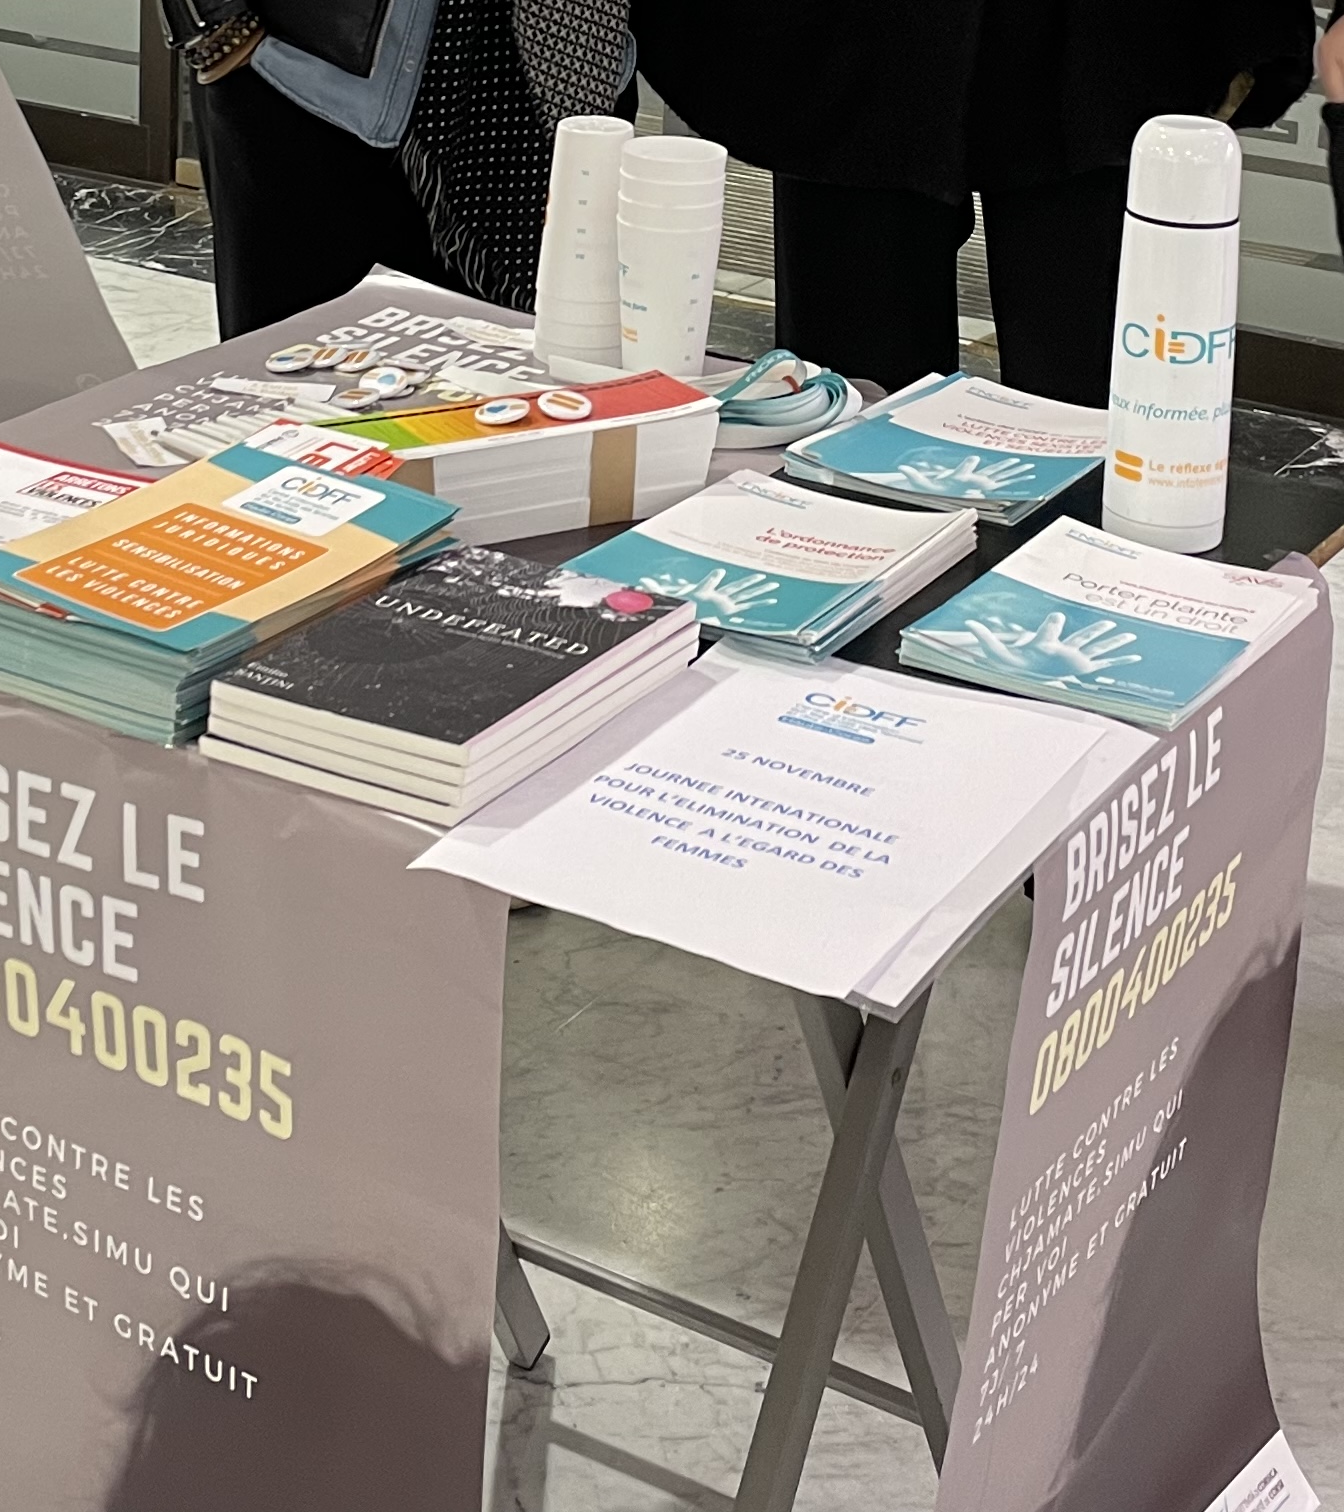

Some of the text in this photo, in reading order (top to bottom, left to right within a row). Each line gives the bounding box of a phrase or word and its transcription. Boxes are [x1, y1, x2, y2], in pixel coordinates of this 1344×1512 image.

[1149, 459, 1213, 476] Le réflexe
[110, 537, 246, 590] SENSIBILISATION
[152, 519, 287, 573] JURIDIQUES
[173, 511, 306, 563] INFORMATIONS
[755, 535, 886, 562] de protection
[765, 526, 897, 554] L'ordonnance
[46, 564, 182, 622] LES VIOLENCES
[68, 555, 204, 611] LUTTE CONTRE
[1062, 571, 1249, 628] Porter plainte
[375, 594, 589, 657] UNDEFEATED
[1084, 591, 1240, 637] est un droit
[720, 747, 877, 798] 25 NOVEMBRE
[593, 773, 891, 867] POUR L'ELIMINATION DE LA
[623, 761, 901, 847] JOURNEE INTENATIONALE
[1061, 704, 1226, 923] BRISEZ LE
[122, 801, 206, 904] LE
[588, 793, 865, 882] VIOLENCE A L'EGARD DES
[651, 833, 749, 871] FEMMES
[1044, 825, 1192, 1020] SILENCE
[1028, 851, 1244, 1118] 0800400235
[1008, 1037, 1181, 1233] LUTTE CONTRE LES
[1152, 1088, 1185, 1141] QUI
[146, 1174, 207, 1222] LES
[1003, 1144, 1109, 1261] VIOLENCES
[983, 1134, 1190, 1377] ANONYME ET GRATUIT
[168, 1264, 232, 1314] QUI
[989, 1238, 1070, 1337] PER VOI
[63, 1285, 101, 1322] ET
[111, 1311, 259, 1402] GRATUIT
[971, 1351, 1042, 1448] 24H/24
[977, 1345, 1027, 1412] 7J/ 7
